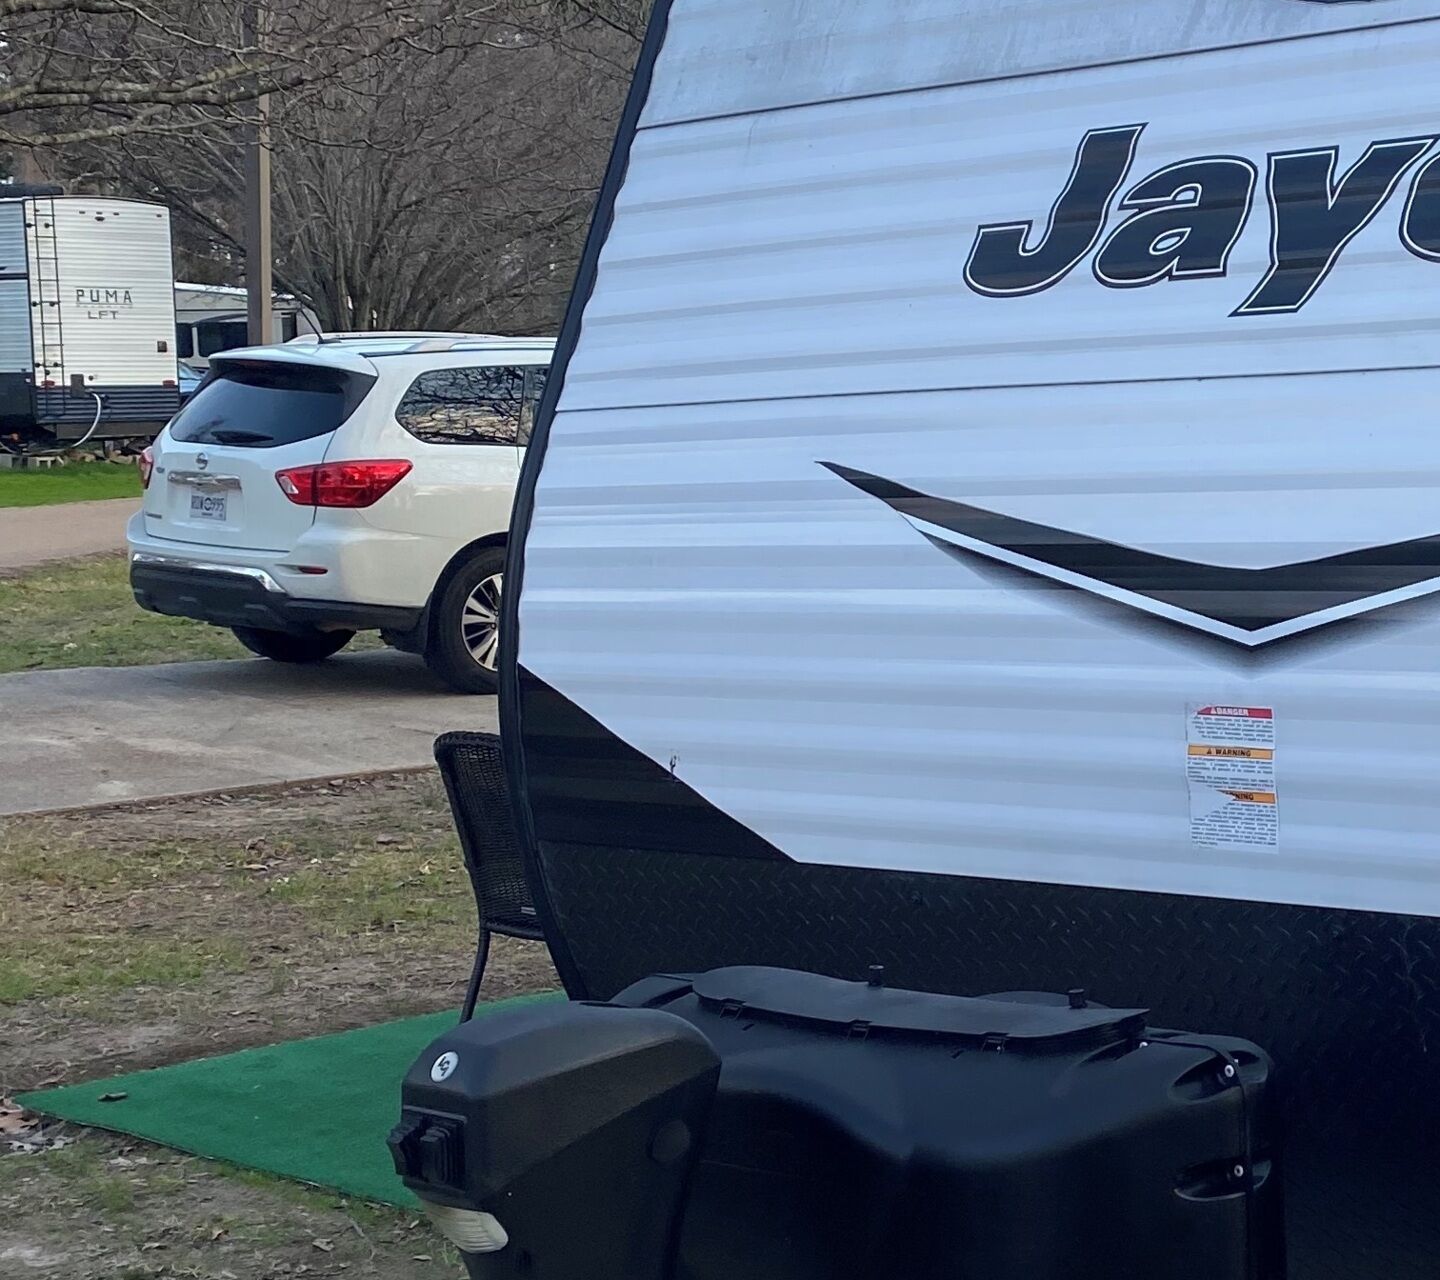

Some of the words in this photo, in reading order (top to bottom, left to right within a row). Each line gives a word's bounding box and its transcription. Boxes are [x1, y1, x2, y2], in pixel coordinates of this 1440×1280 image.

[75, 288, 133, 304] PUMA
[1216, 707, 1249, 716] DANGER
[1215, 749, 1251, 757] WARNING
